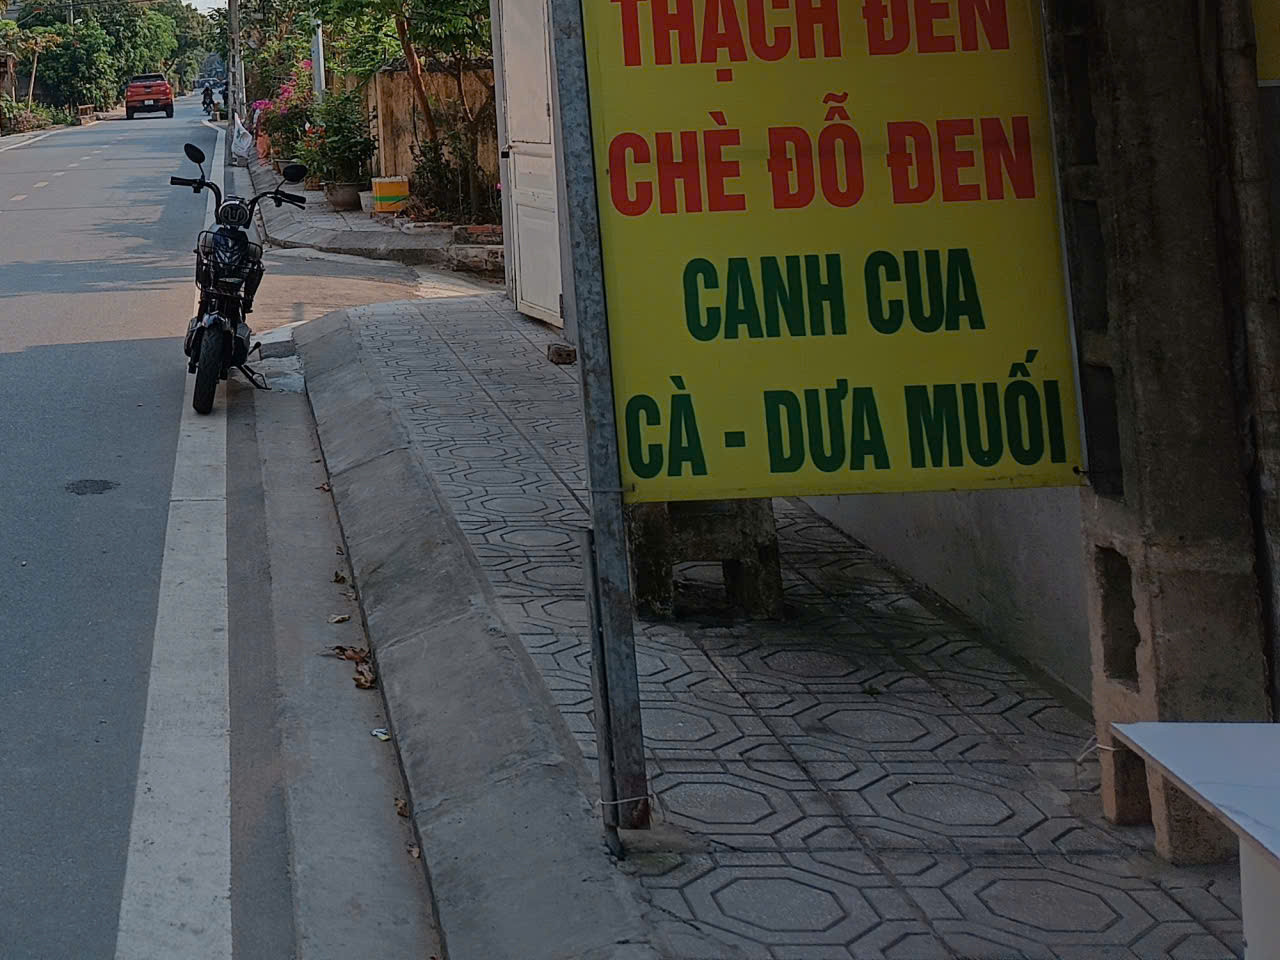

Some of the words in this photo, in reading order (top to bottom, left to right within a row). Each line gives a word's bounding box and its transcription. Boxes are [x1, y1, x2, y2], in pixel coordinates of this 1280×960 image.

[608, 111, 746, 216] CHÈ
[767, 91, 864, 209] ĐỖ
[886, 115, 1036, 204] ĐEN
[683, 253, 847, 342] CANH
[864, 248, 985, 334] CUA
[624, 375, 708, 479] CÀ
[763, 378, 890, 473] DƯA
[904, 350, 1067, 469] MUỐI
